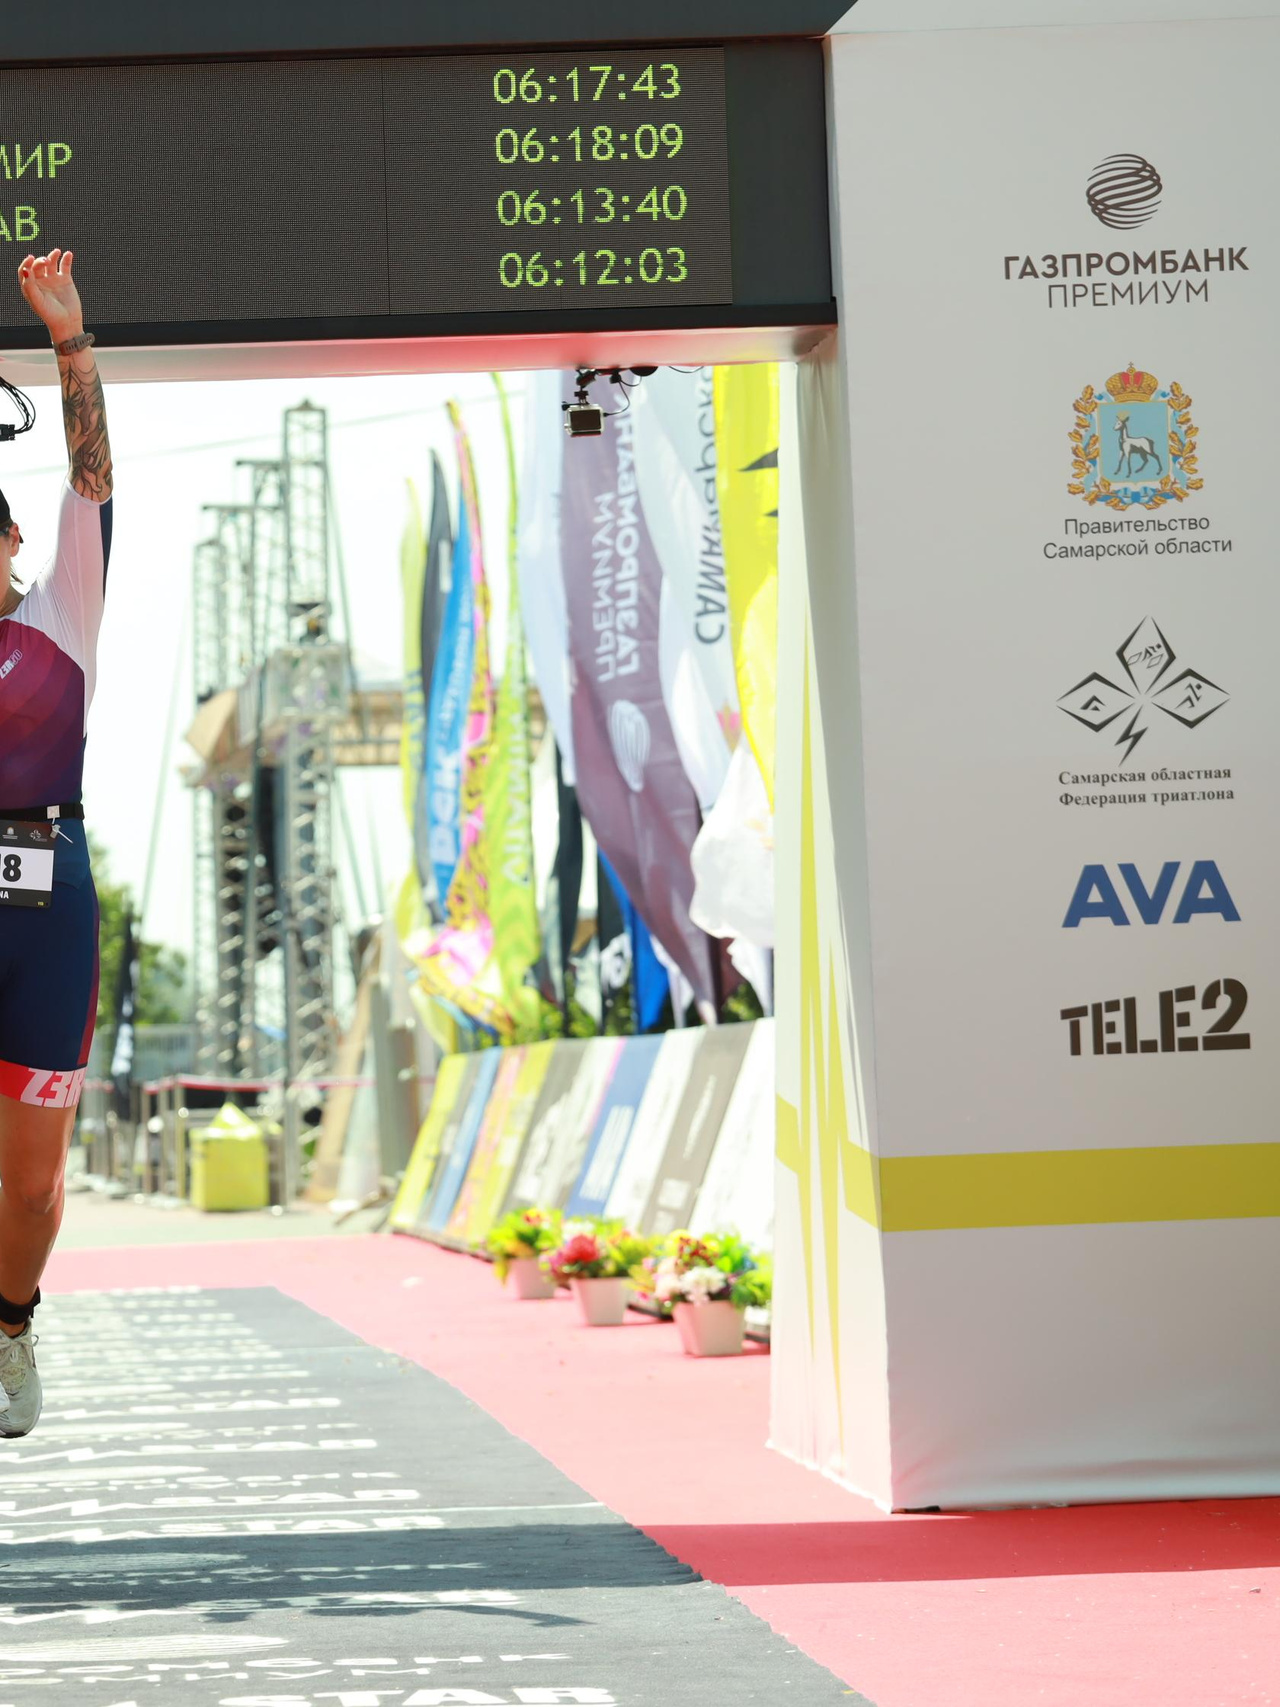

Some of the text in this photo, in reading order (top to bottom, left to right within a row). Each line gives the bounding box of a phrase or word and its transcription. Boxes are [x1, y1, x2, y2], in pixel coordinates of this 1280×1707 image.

[494, 64, 681, 103] 06:17:43
[496, 124, 683, 163] 06:18:09
[496, 186, 687, 225] 06:13:40
[498, 248, 687, 287] 06:12:03
[1005, 247, 1249, 279] ГАЗПРОМБАНК
[1048, 279, 1208, 308] ПРЕМИУМ
[1064, 515, 1210, 537] Правительство
[1043, 538, 1232, 560] Самарской области
[1059, 767, 1231, 786] Самарская областная
[1059, 788, 1234, 807] Федерация триатлона
[1062, 860, 1241, 928] AVA
[1061, 978, 1250, 1056] TELE2
[155, 1516, 449, 1535] STAR
